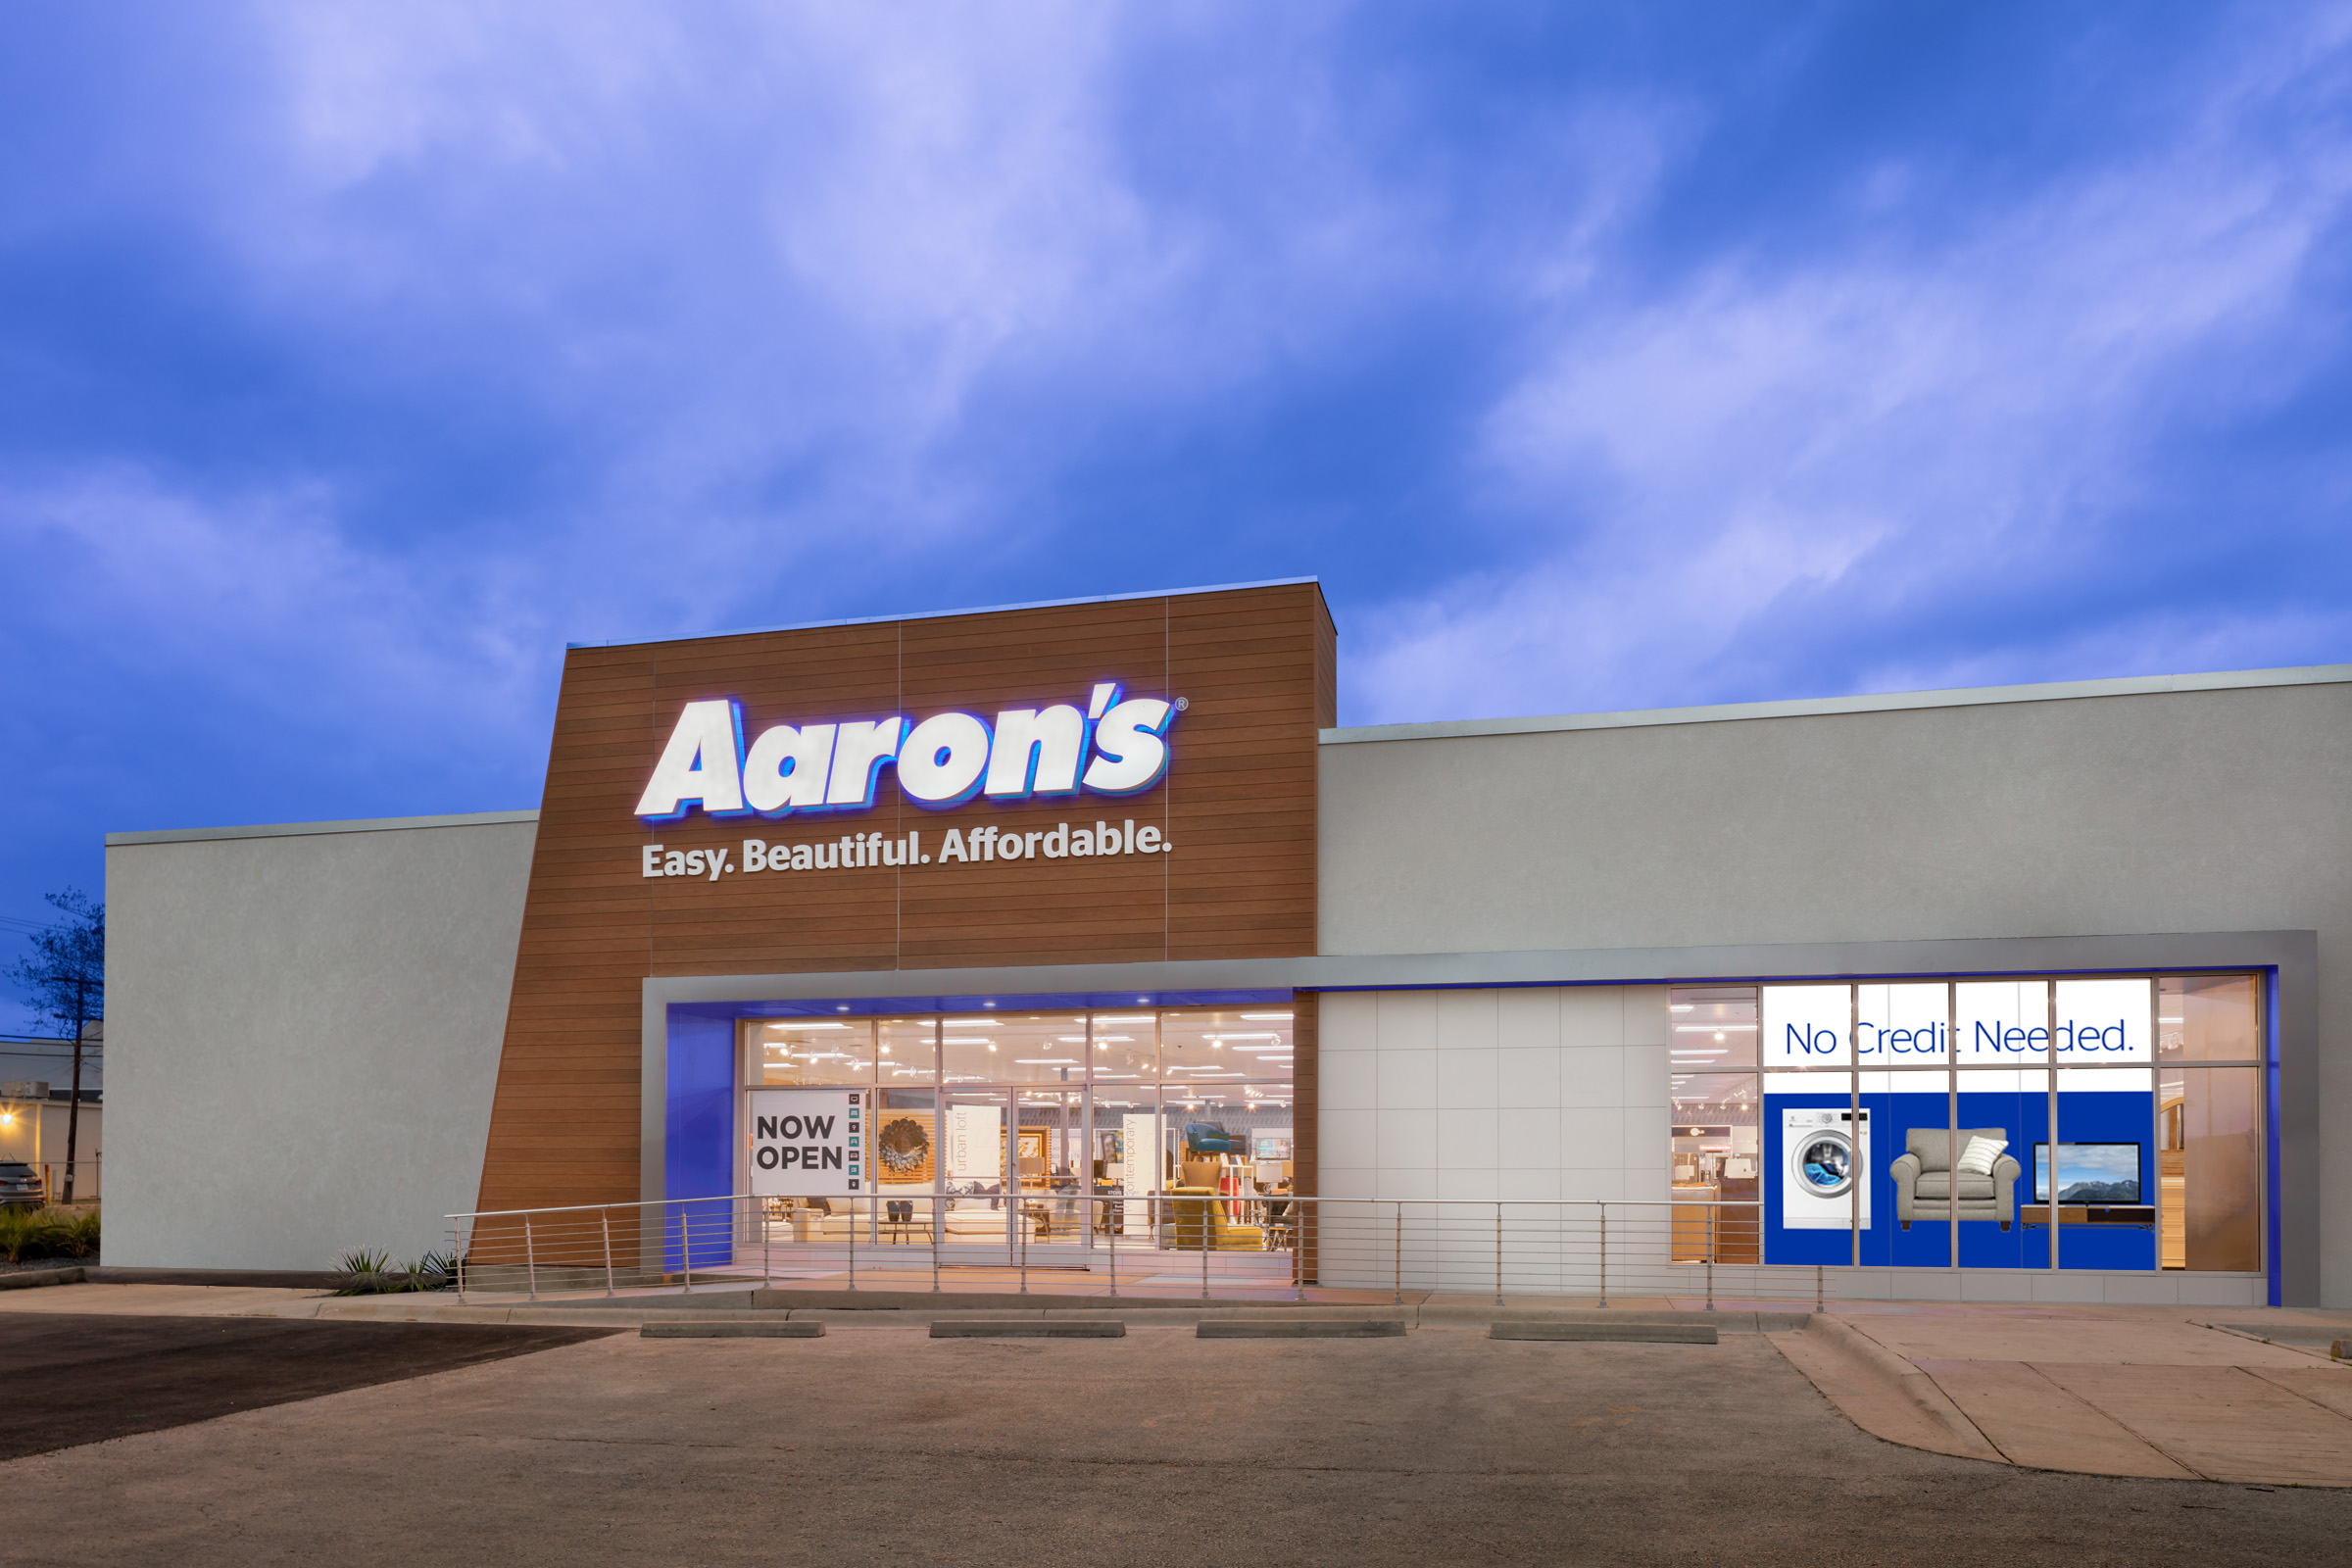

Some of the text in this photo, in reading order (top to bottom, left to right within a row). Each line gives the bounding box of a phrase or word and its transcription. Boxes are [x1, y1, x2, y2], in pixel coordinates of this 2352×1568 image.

[633, 682, 1173, 817] Aaron's
[641, 819, 1173, 882] Easy. Beautiful. Affordable.
[1786, 1022, 1838, 1055] No
[1975, 1019, 2134, 1054] Needed.
[757, 1115, 836, 1140] NOW
[955, 1110, 967, 1171] urban loft
[757, 1146, 843, 1170] OPEN
